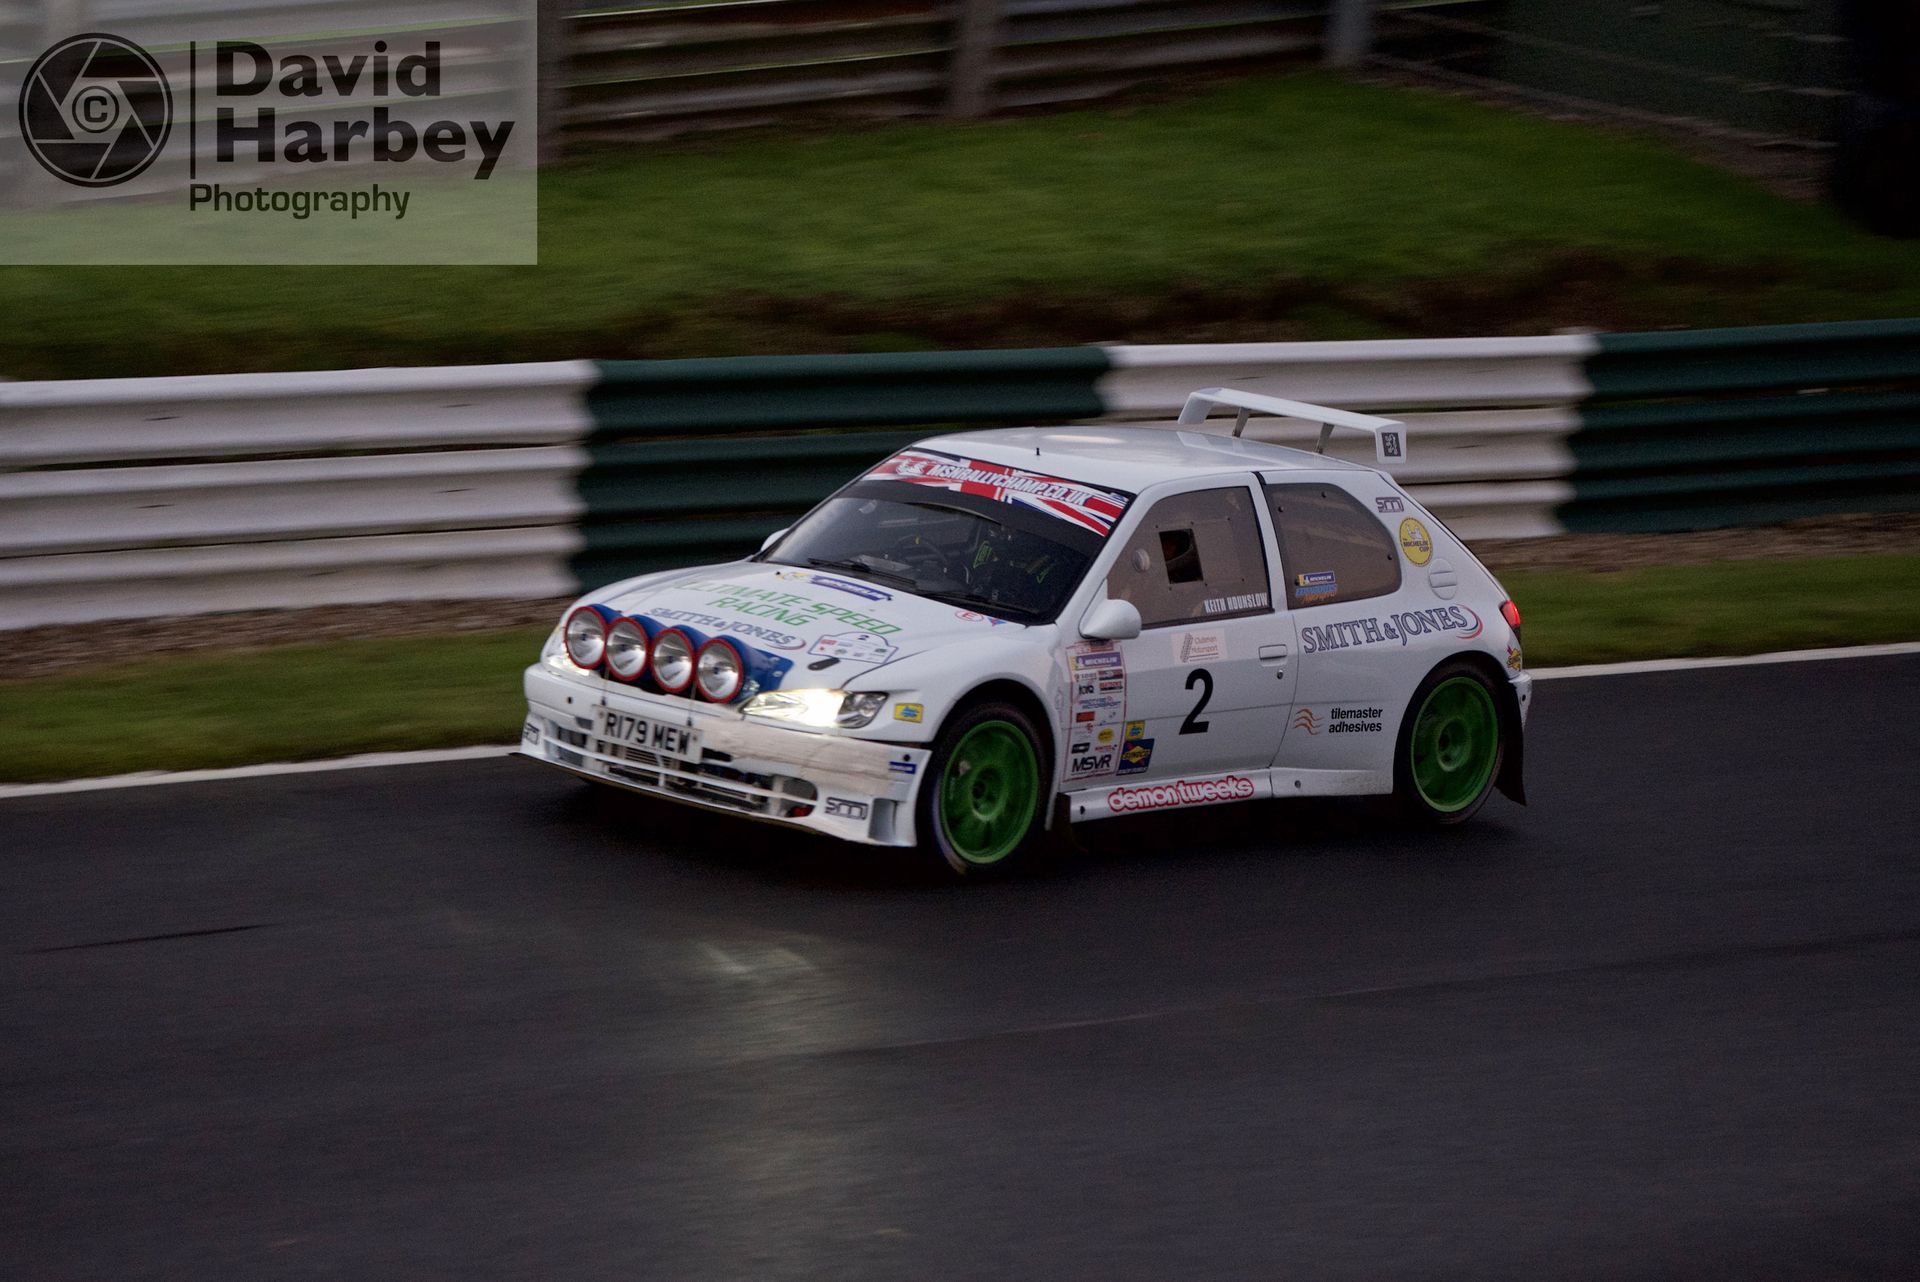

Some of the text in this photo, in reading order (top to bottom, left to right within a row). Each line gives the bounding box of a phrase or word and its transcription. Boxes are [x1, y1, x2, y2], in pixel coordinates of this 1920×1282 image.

[706, 597, 817, 626] RACING
[1203, 592, 1268, 614] KEITH HOUNSLOW
[800, 602, 903, 635] SPEED
[1179, 668, 1213, 735] 2
[1331, 707, 1383, 719] tilemaster
[605, 712, 691, 755] R179 MEW
[1329, 720, 1382, 733] adhesives
[1072, 754, 1112, 772] MSVR
